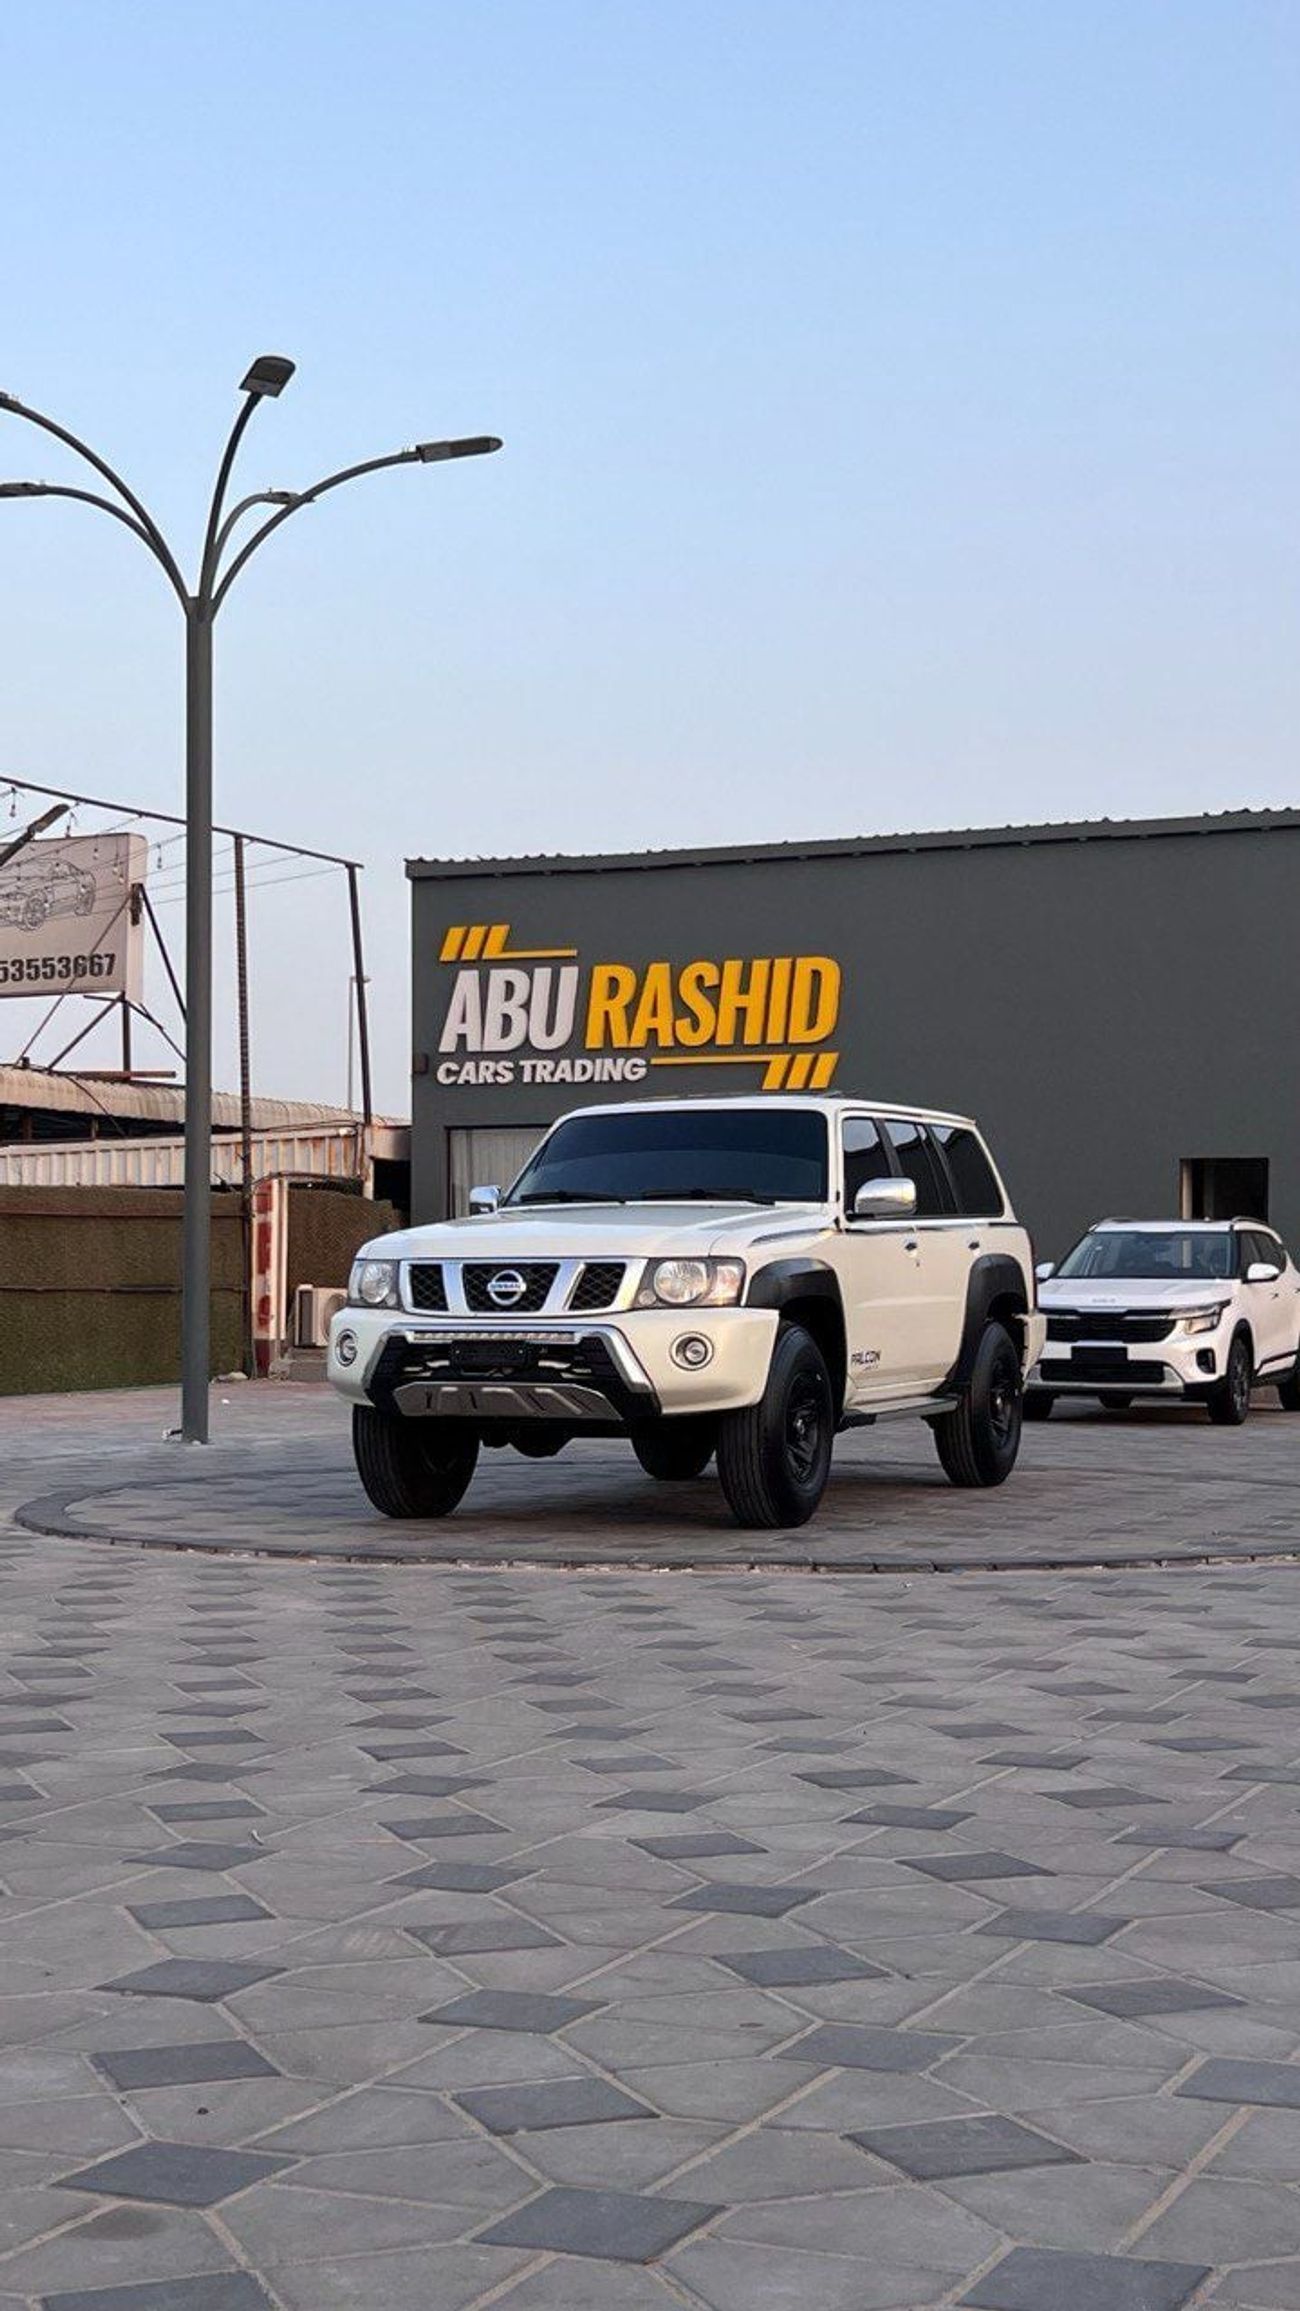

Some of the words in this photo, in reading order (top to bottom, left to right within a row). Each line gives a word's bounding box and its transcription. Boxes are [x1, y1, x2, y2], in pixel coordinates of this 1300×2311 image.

[439, 966, 579, 1053] ABU
[585, 956, 841, 1049] RASHID
[436, 1061, 515, 1085] CARS
[519, 1057, 647, 1083] TRADING
[851, 1350, 881, 1365] FALCON
